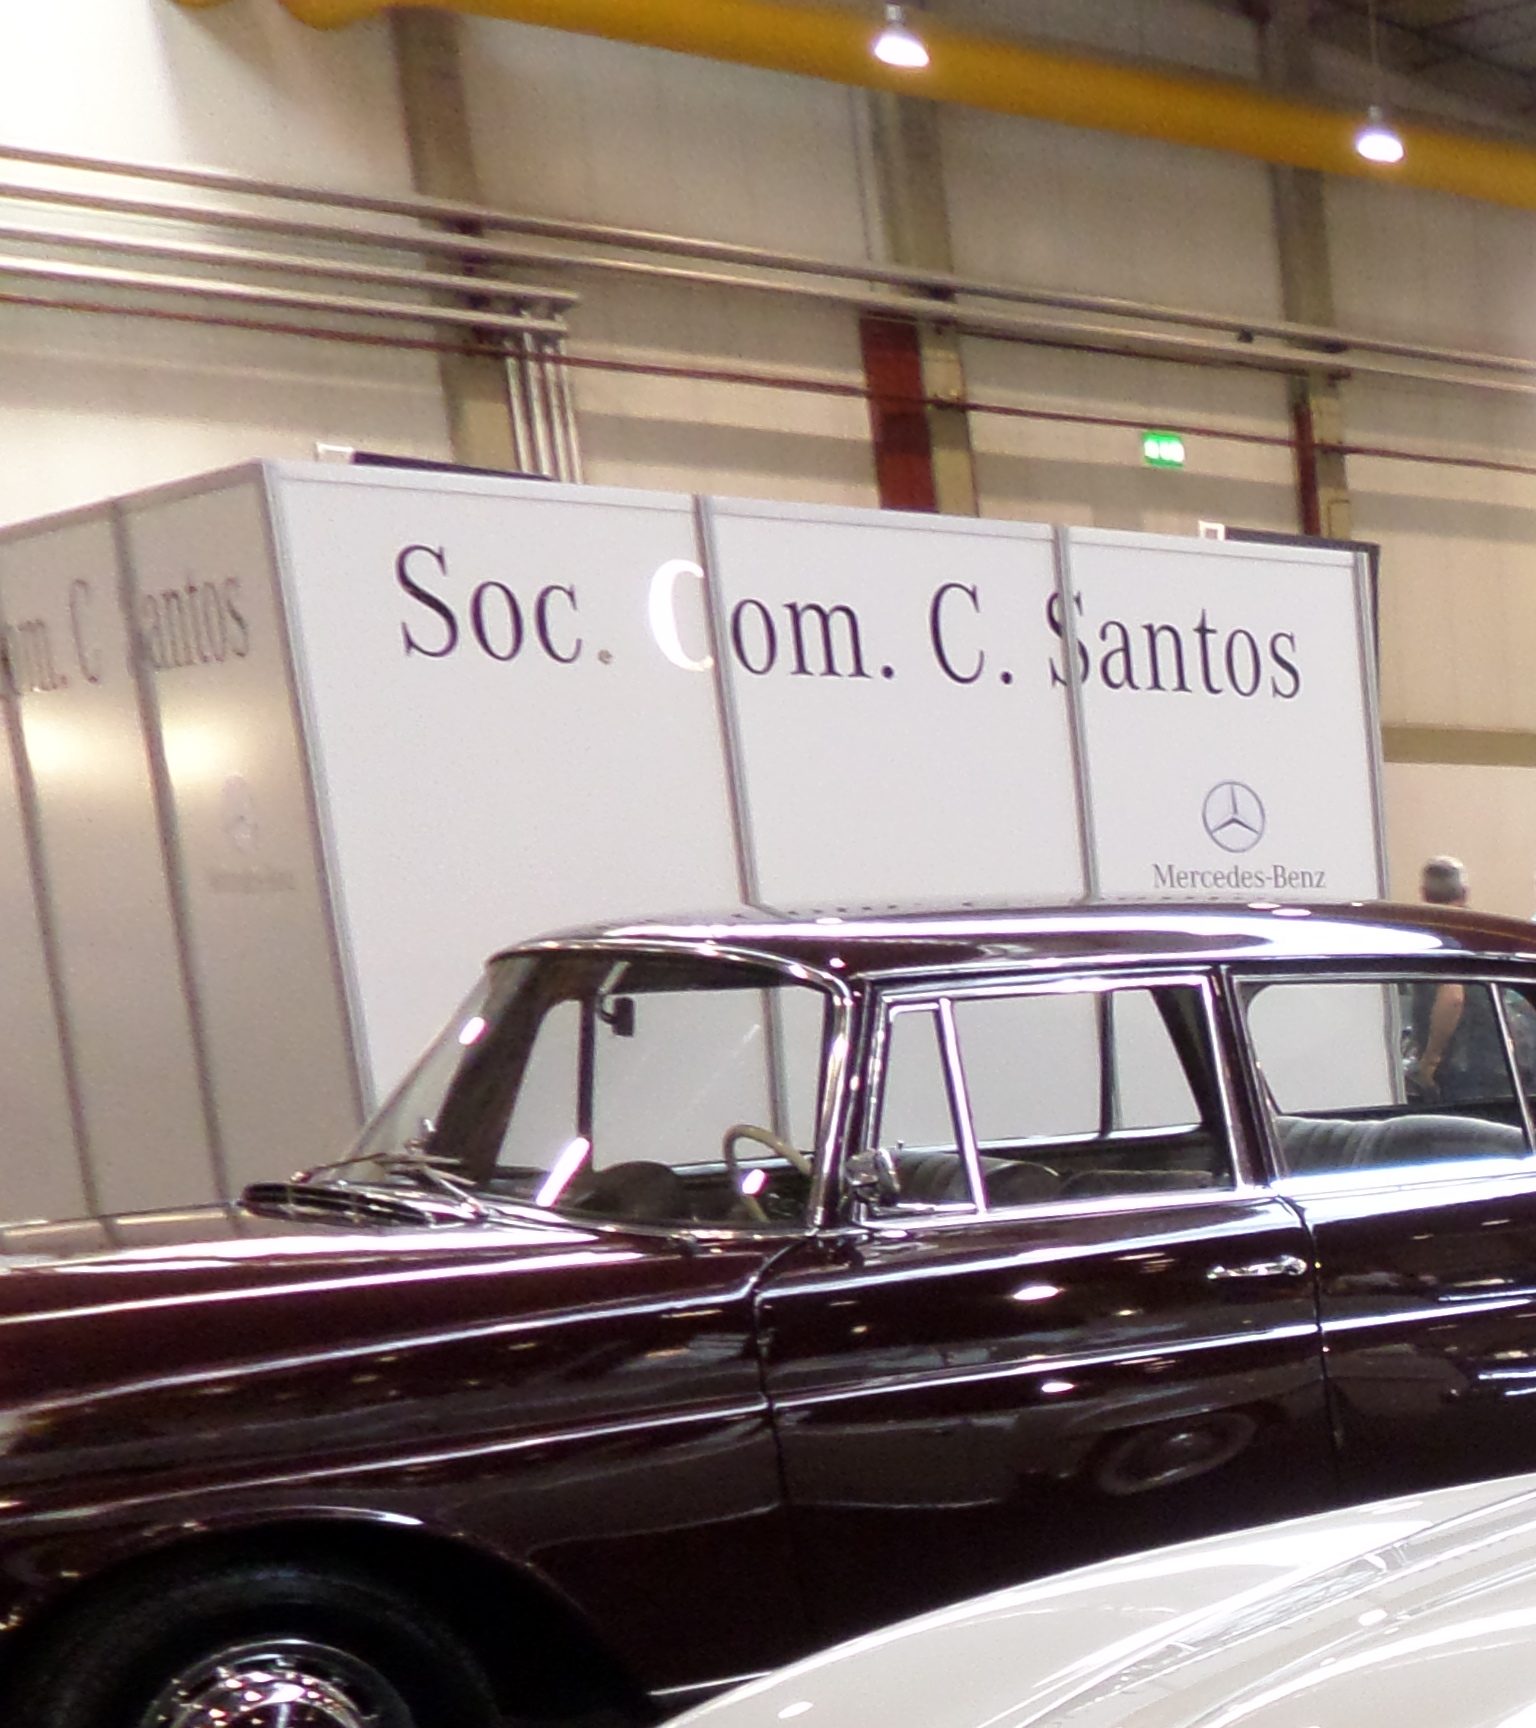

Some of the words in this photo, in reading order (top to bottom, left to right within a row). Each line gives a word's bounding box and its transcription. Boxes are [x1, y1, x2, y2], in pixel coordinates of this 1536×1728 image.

[395, 543, 614, 668] Soc.
[647, 558, 895, 681] Com.
[930, 582, 1013, 686] C.
[1047, 590, 1302, 700] Santos
[1152, 863, 1327, 889] Mercedes-Benz
